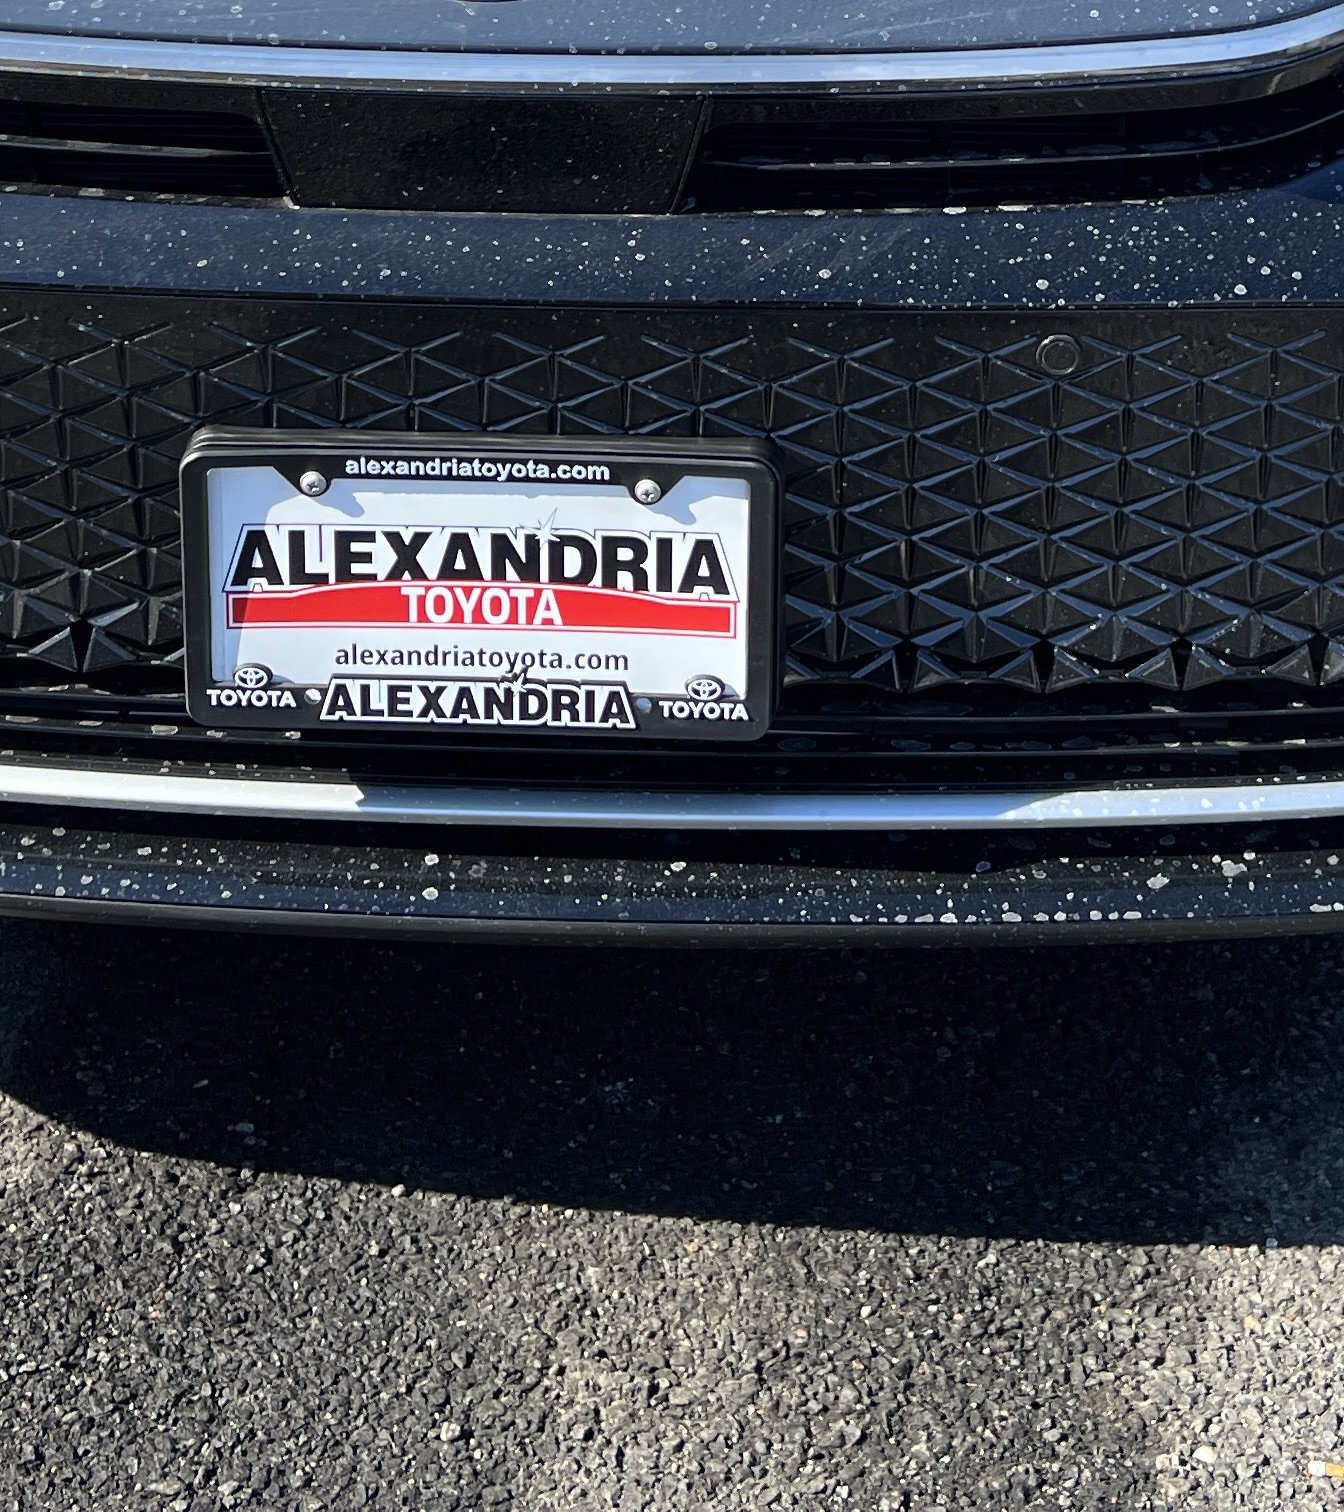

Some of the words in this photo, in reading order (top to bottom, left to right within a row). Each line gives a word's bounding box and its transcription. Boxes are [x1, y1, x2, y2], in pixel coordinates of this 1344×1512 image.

[344, 455, 611, 482] alexandriatoyota.com
[230, 526, 732, 596] ALEXANDRIA
[400, 586, 564, 627] TOYOTA
[334, 642, 630, 673] alexandriatoyota.com
[206, 688, 297, 708] TOYOTA
[322, 679, 633, 727] ALEXANDRIA
[658, 700, 749, 721] TOYOTA
